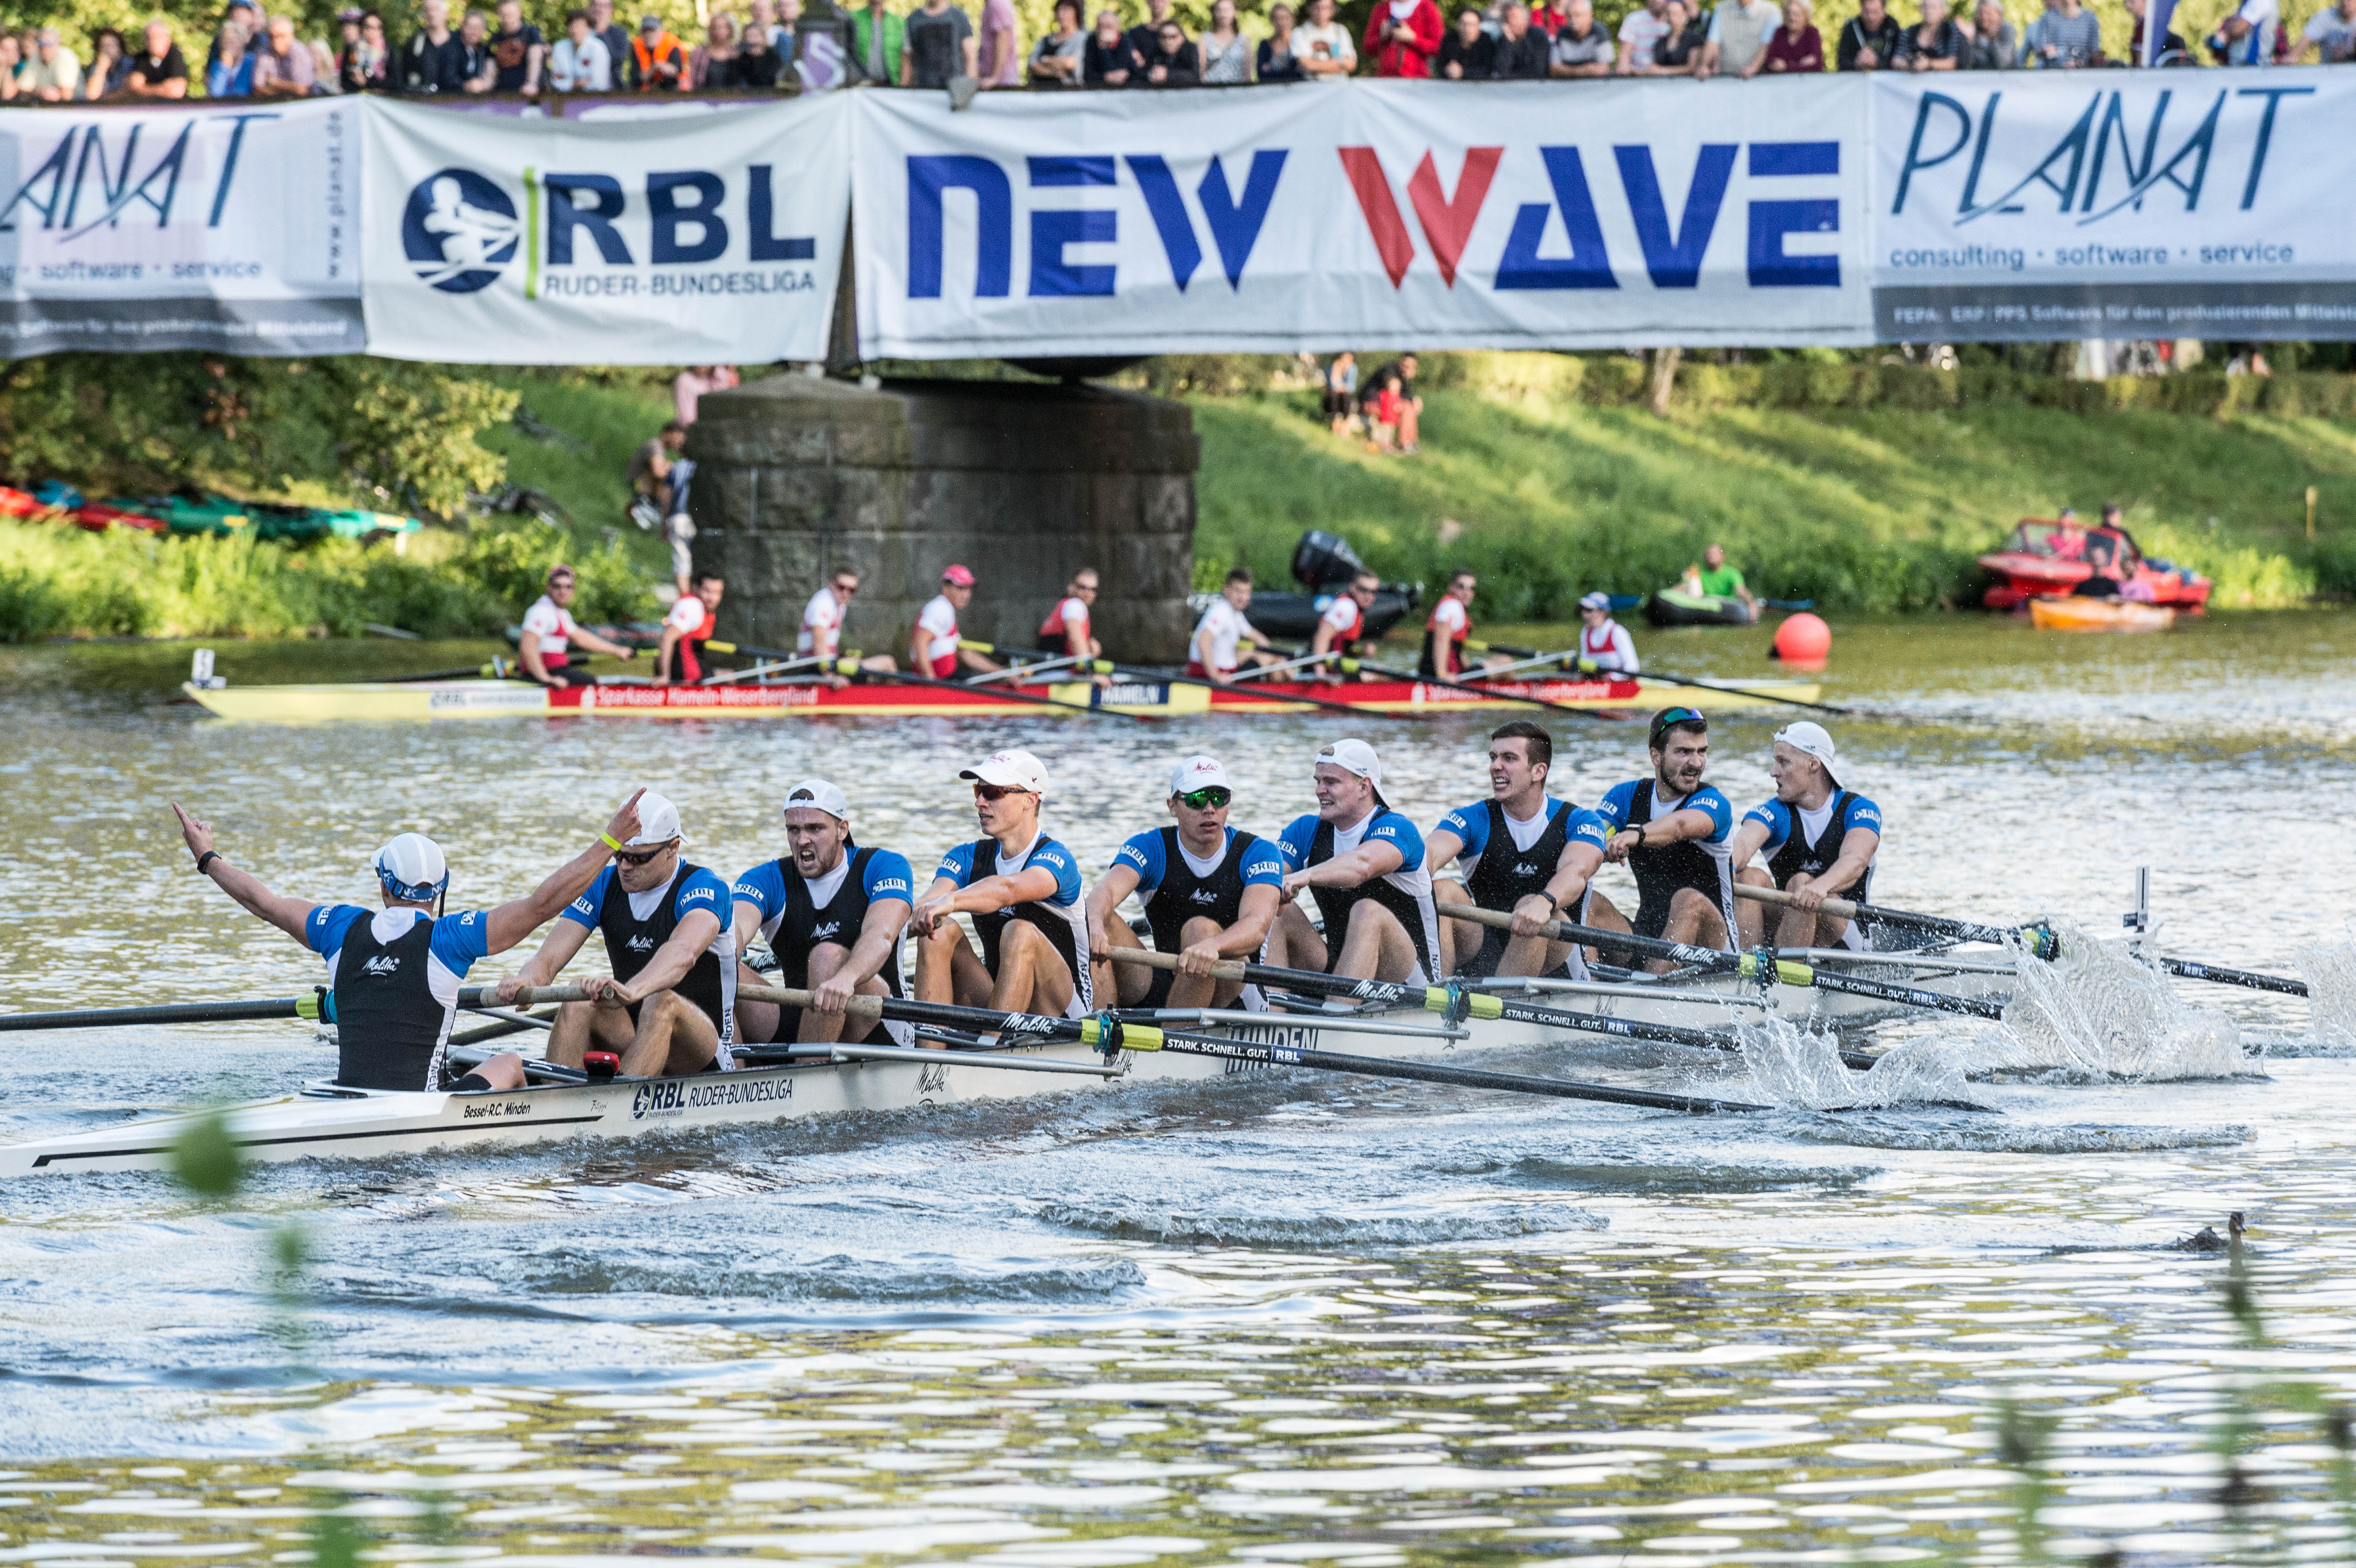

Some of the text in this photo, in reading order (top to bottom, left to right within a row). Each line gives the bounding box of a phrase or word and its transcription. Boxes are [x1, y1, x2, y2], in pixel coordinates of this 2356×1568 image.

[1890, 86, 2318, 227] PLANAT
[0, 114, 281, 242] ANAT
[544, 164, 816, 265] RBL
[906, 142, 1842, 298] NEW WAVE
[1890, 242, 2294, 272] consulting software service
[41, 259, 142, 281] software
[173, 258, 262, 279] service
[545, 271, 816, 297] RUDER-BUNDESLIGA
[1128, 847, 1147, 866] RBL
[1260, 861, 1280, 873] RBL
[688, 888, 714, 901] RBL
[883, 878, 906, 890] RBL
[1349, 979, 1398, 1002] Melitta
[999, 1011, 1054, 1034] Melitta
[1505, 1009, 1602, 1030] STARK. SCHNELL. GUT.
[1607, 1022, 1631, 1034] RBL
[1167, 1038, 1268, 1059] STARK. SCHNELL. GUT.
[1276, 1049, 1301, 1062] RBL
[650, 1081, 686, 1111] RBL
[688, 1078, 793, 1108] RUDER-BUNDESLIGA
[463, 1101, 531, 1119] Bessel-R.C. Minden
[649, 1110, 683, 1118] RUDER-BUNDESLIGA
